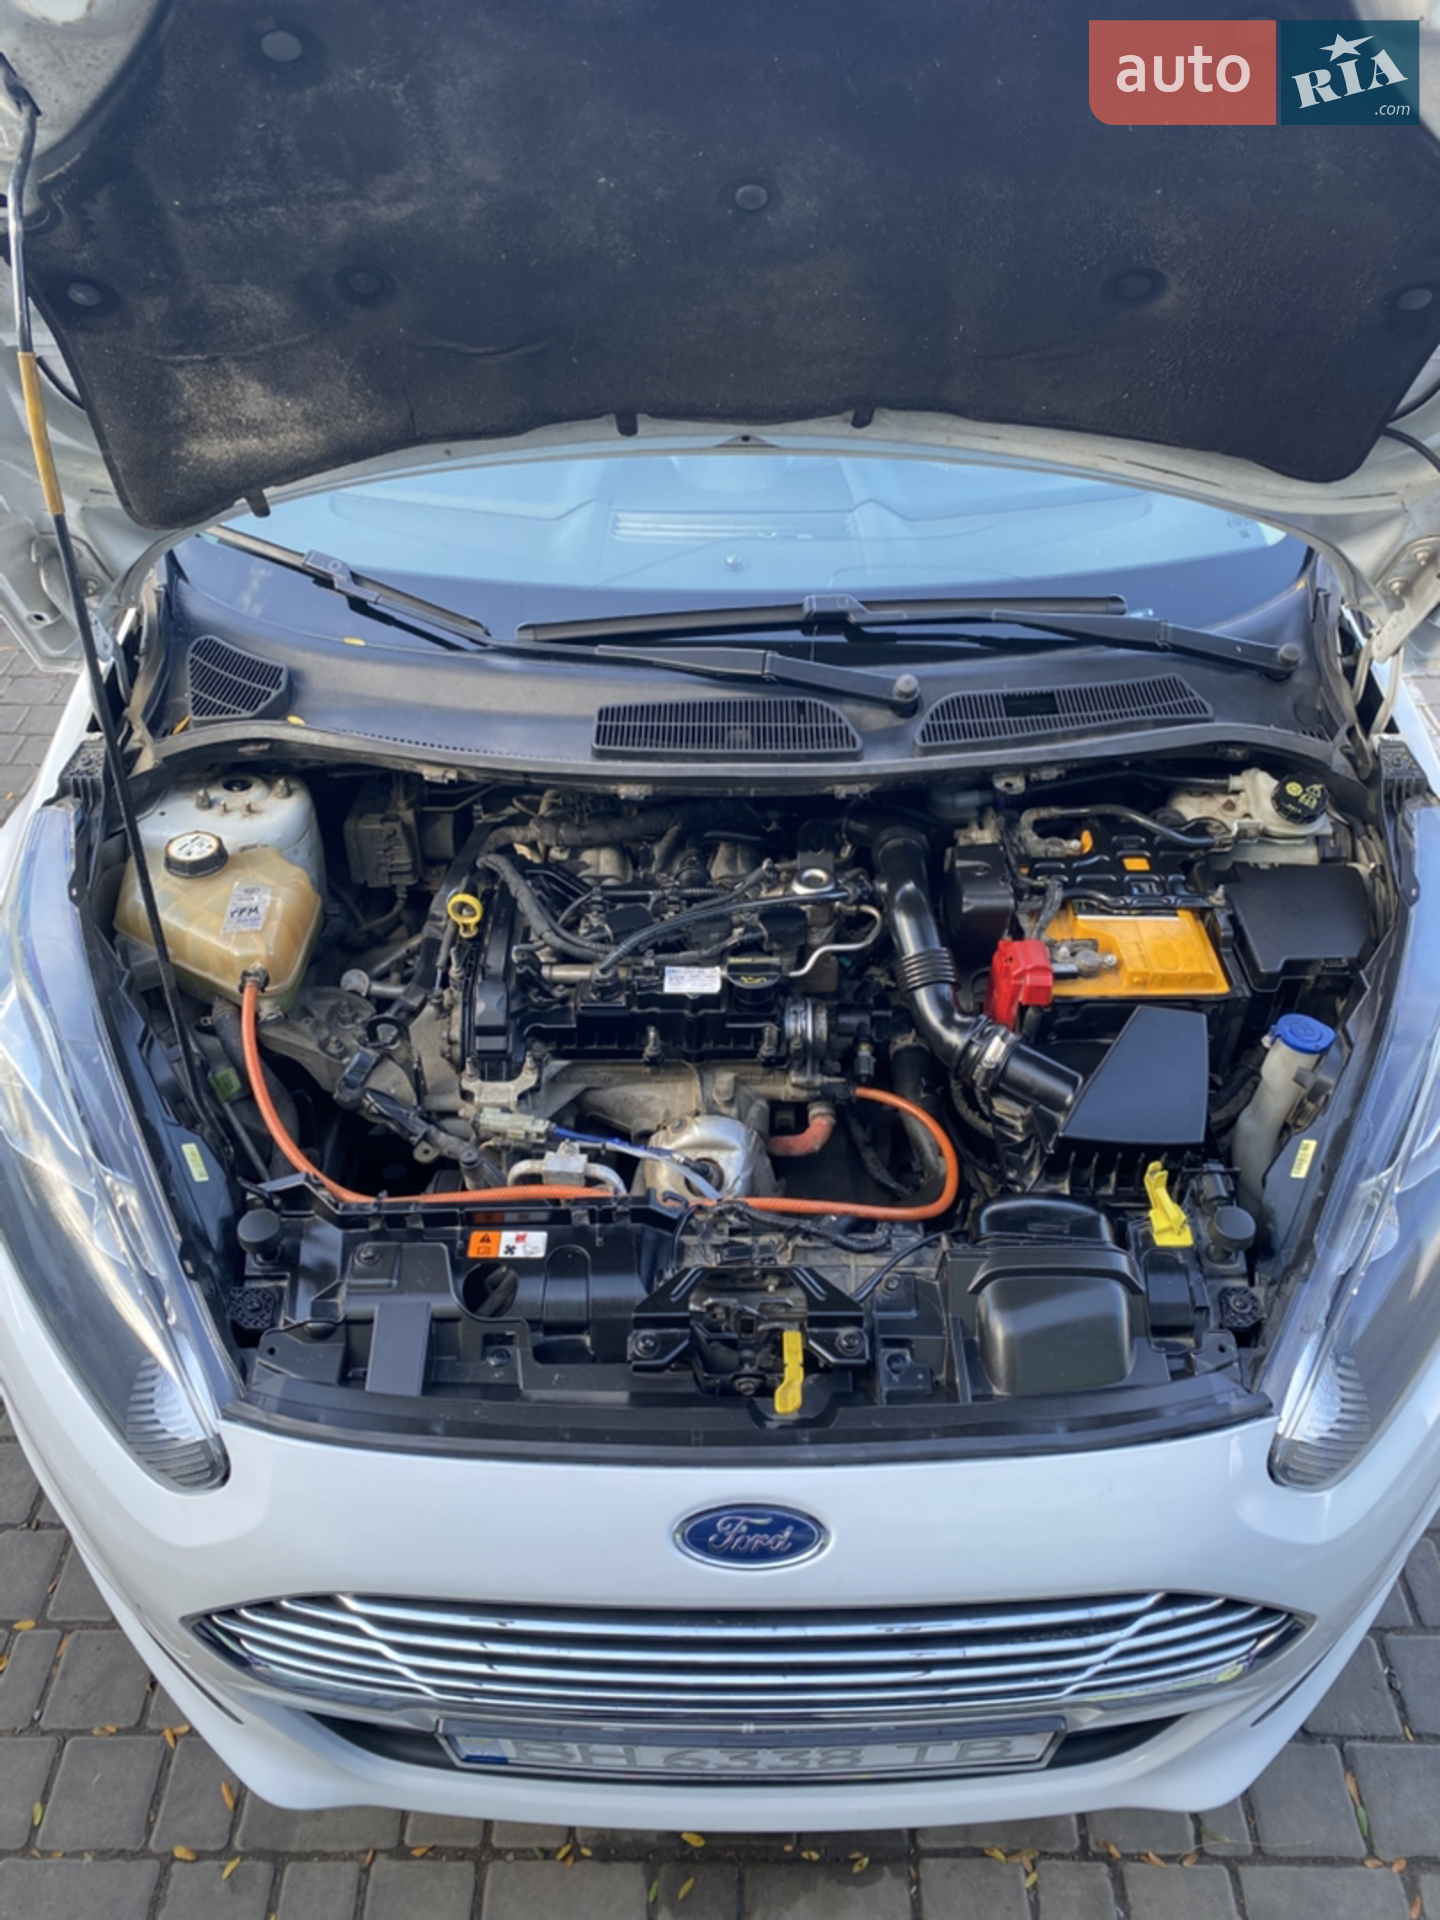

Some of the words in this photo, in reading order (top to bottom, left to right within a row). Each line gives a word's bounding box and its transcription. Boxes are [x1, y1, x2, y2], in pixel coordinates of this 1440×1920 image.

[708, 1516, 793, 1553] Ford
[513, 1740, 638, 1767] BH
[663, 1746, 864, 1770] 6338
[896, 1738, 1013, 1764] TB
